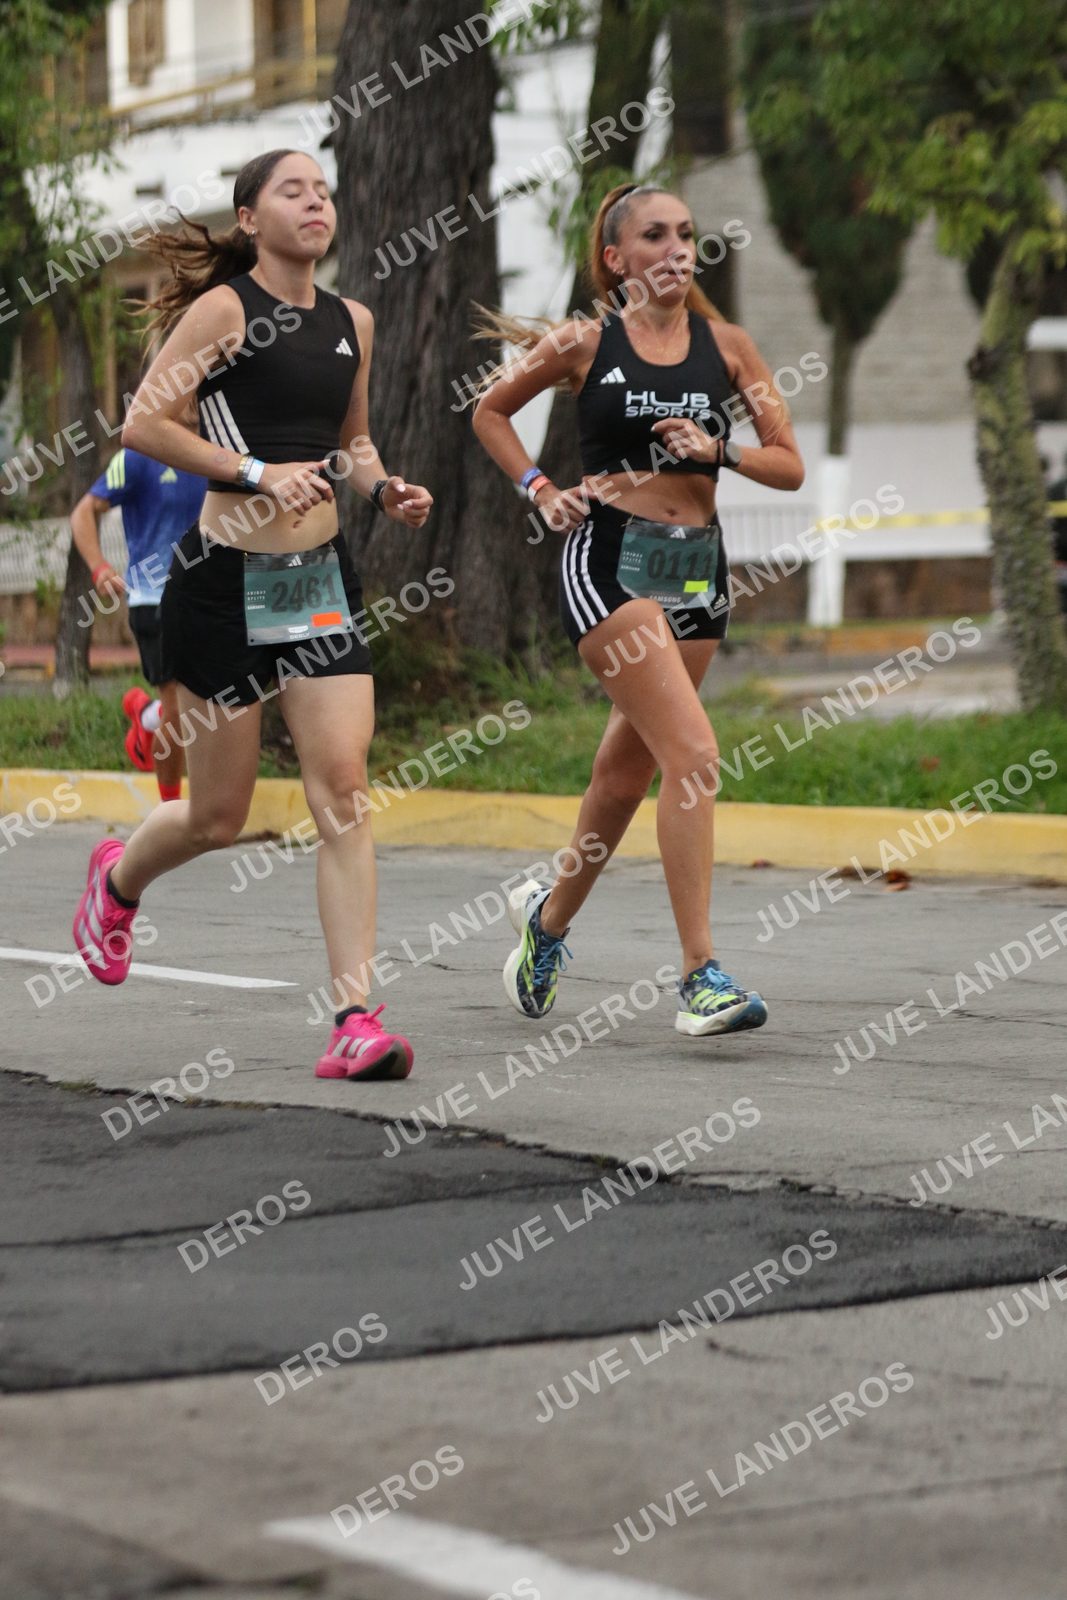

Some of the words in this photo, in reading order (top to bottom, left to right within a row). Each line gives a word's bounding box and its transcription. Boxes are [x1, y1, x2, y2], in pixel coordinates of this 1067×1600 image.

[625, 390, 711, 408] HUB
[625, 406, 711, 420] SPORTS
[647, 549, 714, 580] 0111
[271, 574, 342, 613] 2461
